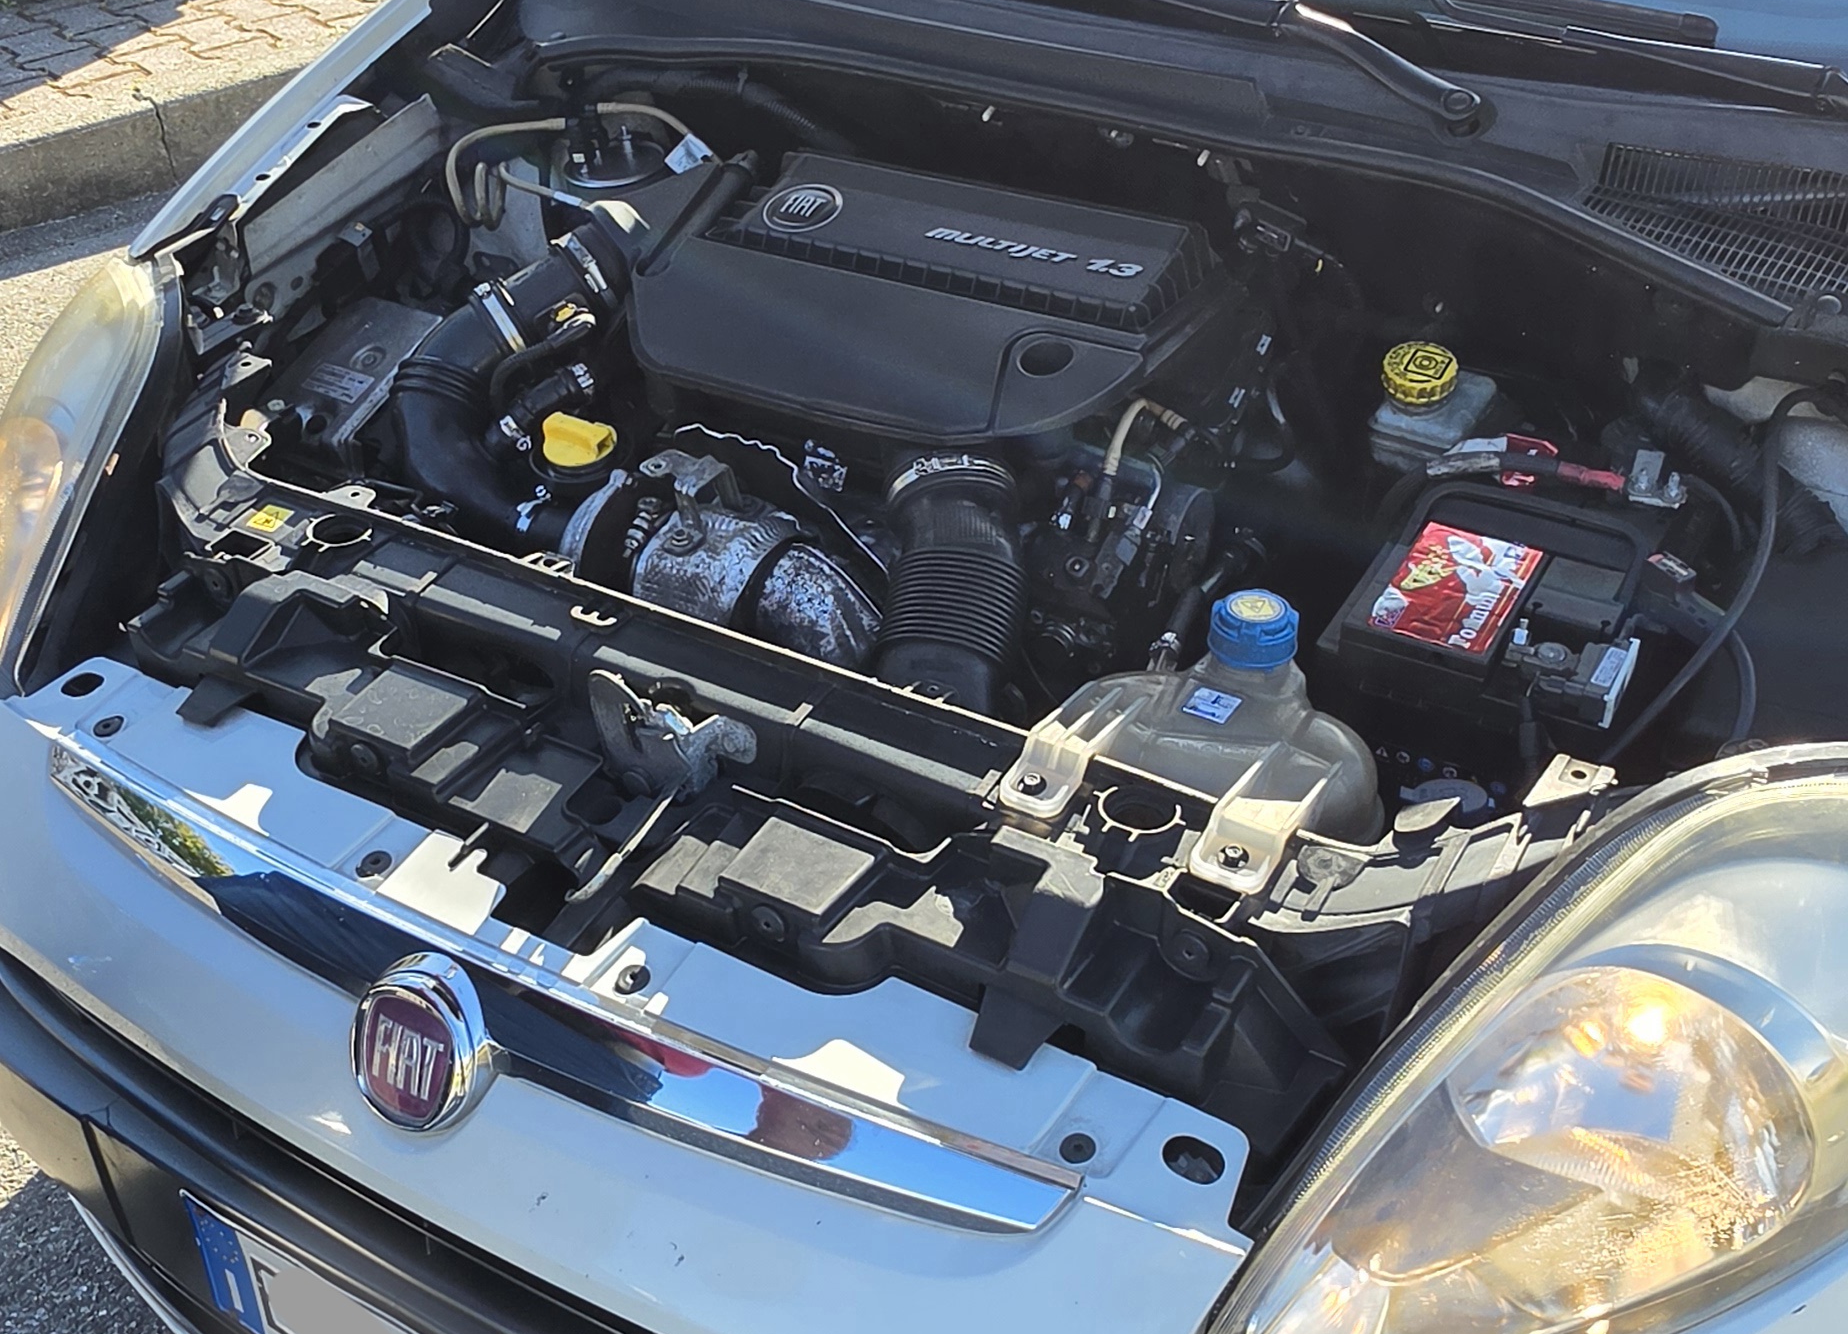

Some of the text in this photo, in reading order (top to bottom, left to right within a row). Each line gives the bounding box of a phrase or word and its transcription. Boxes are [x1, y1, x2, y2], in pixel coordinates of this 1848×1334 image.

[780, 193, 827, 218] FIAT
[924, 227, 1144, 278] MULTIJET 1.3
[371, 1013, 445, 1101] FIAT
